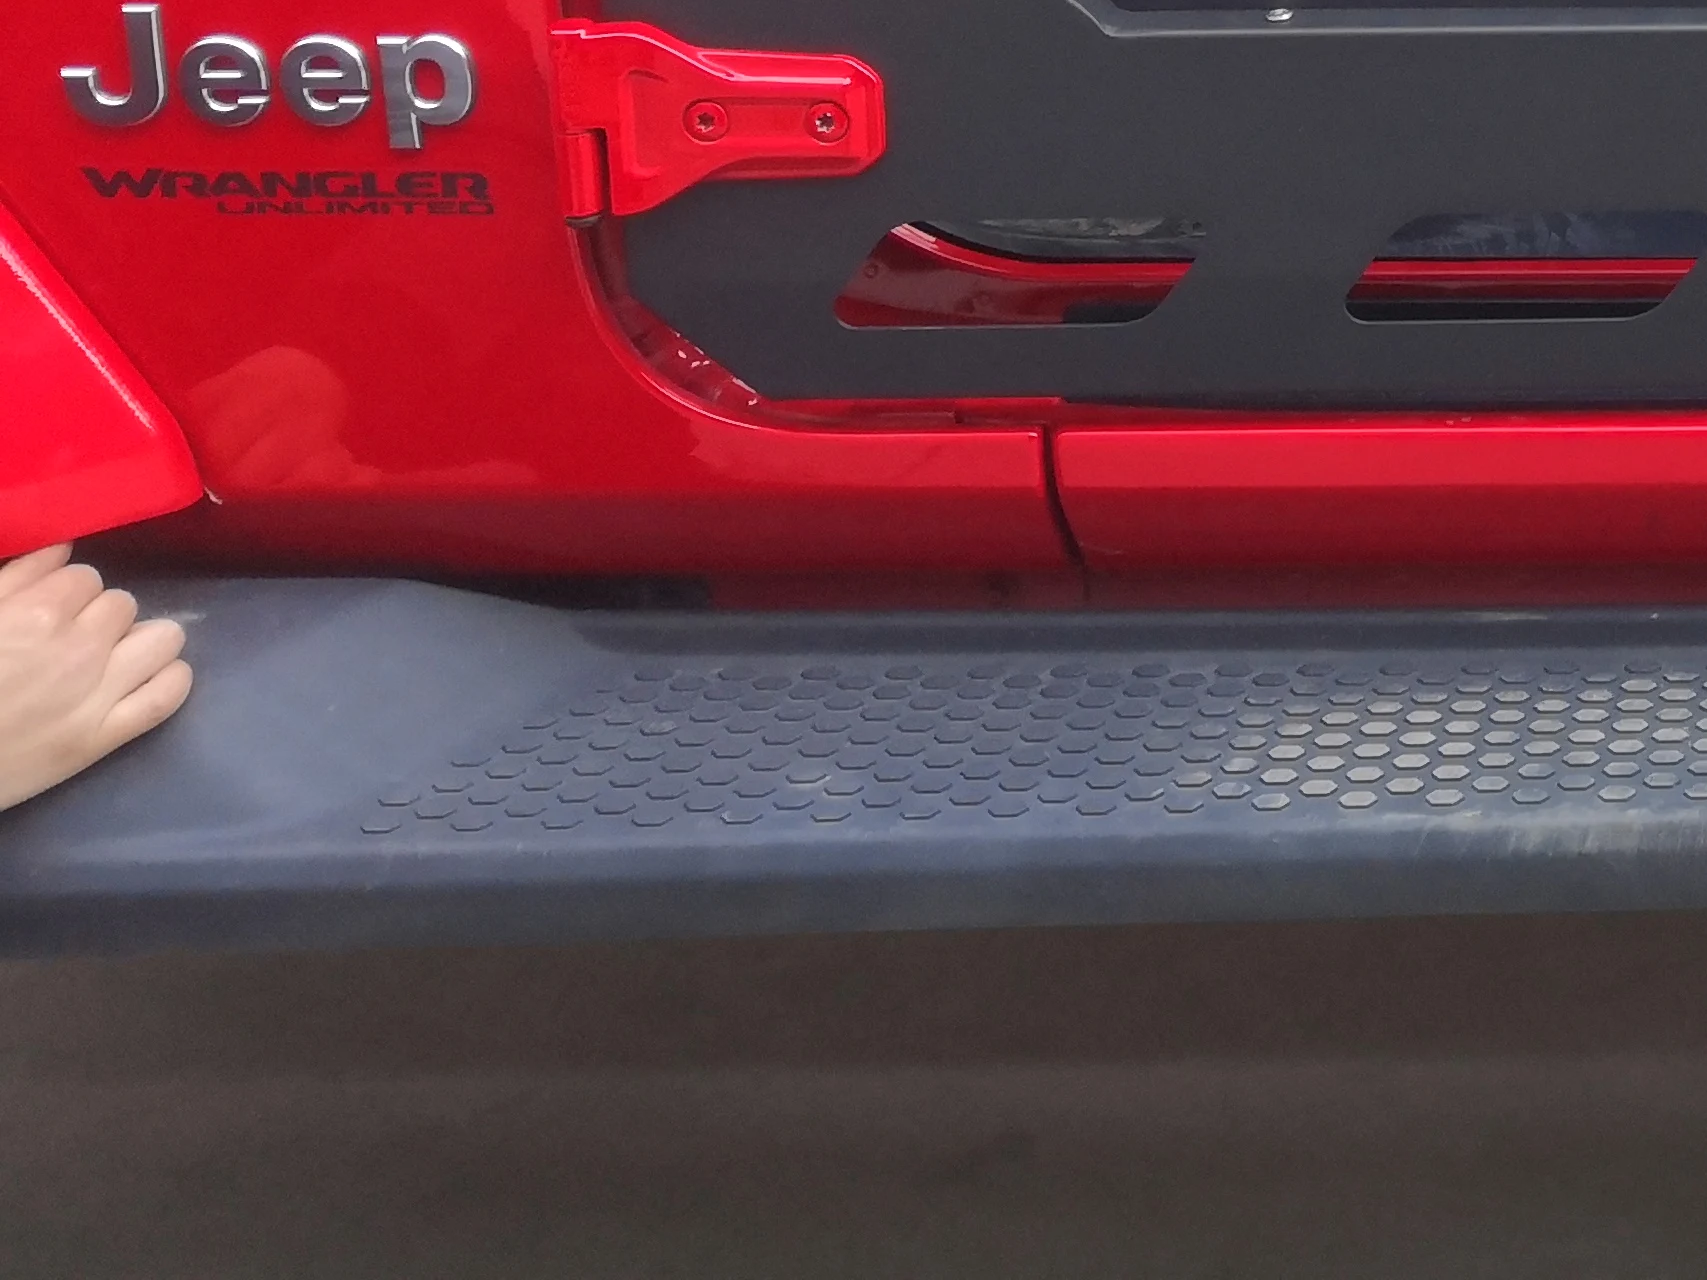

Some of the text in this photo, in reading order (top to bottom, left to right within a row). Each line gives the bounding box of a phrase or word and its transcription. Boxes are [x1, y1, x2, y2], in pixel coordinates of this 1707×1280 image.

[60, 3, 477, 149] Jeep
[80, 166, 489, 200] WRANGLER
[217, 201, 494, 216] UNLIMITED
